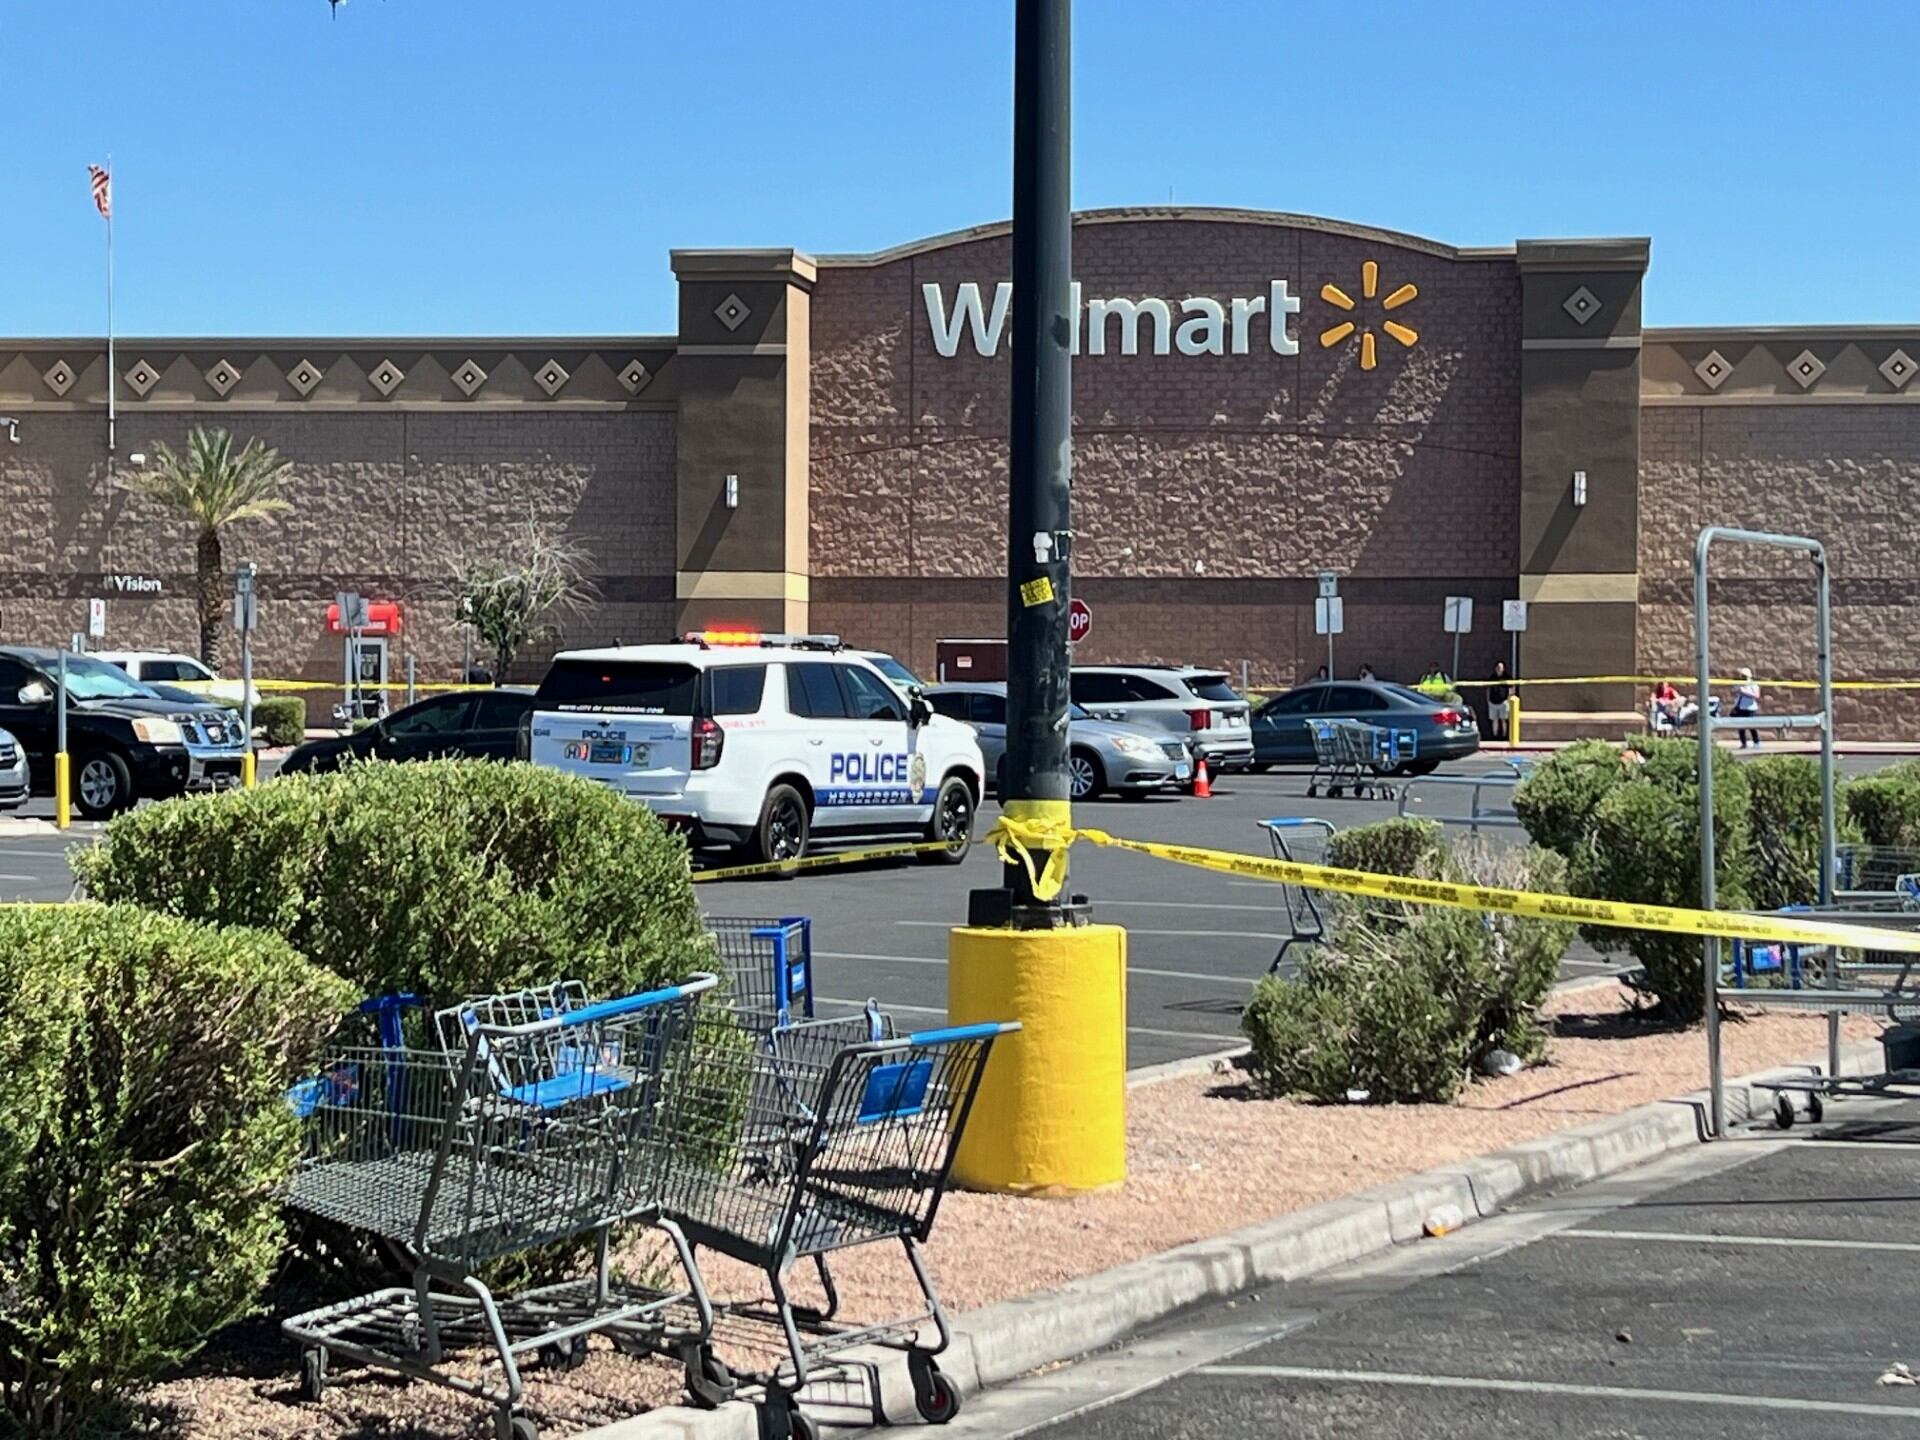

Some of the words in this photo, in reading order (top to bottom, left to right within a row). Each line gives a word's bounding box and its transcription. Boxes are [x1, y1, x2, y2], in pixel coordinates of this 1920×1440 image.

[921, 280, 1301, 357] Wlmart
[114, 575, 162, 592] Vision
[1070, 613, 1089, 629] OP
[582, 729, 627, 741] POLICE
[830, 752, 908, 783] POLICE
[827, 790, 909, 805] HENDERSON
